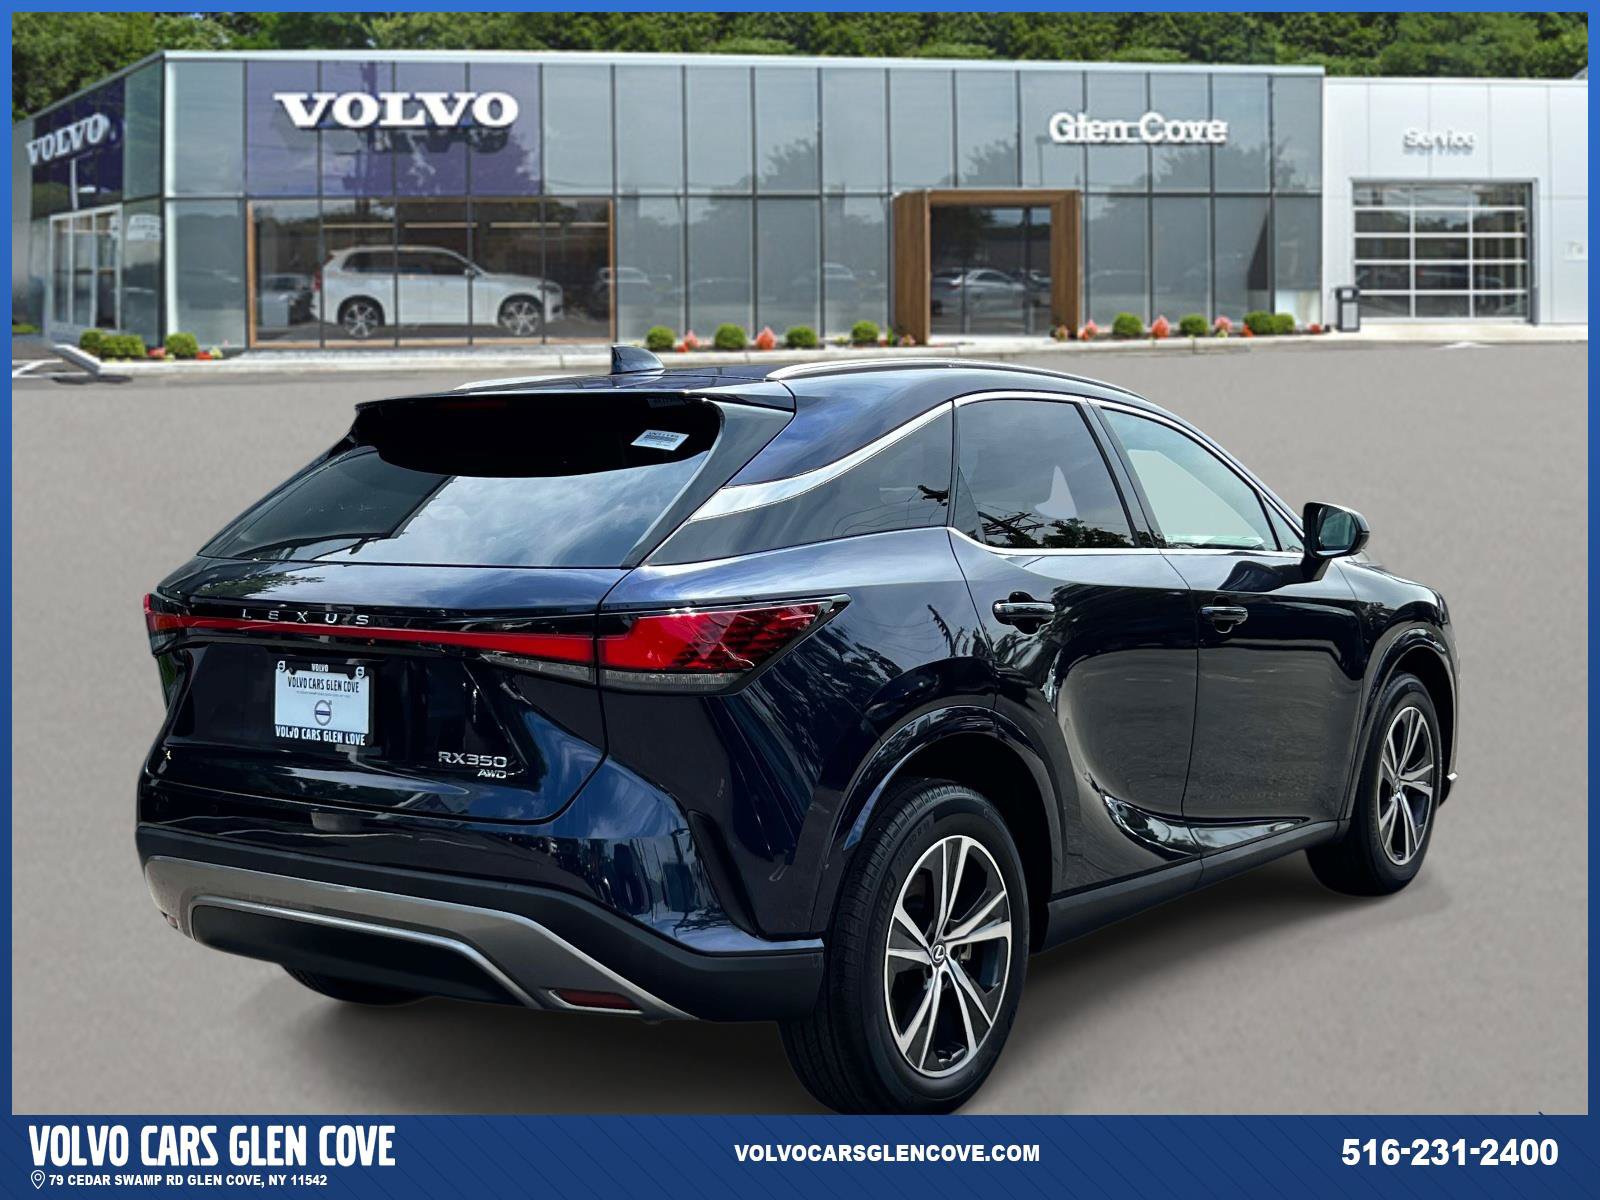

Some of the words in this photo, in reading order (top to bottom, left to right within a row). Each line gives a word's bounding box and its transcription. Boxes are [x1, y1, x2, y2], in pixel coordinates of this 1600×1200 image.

[273, 92, 519, 128] VOLVO
[1049, 111, 1132, 143] Glen
[1138, 111, 1228, 143] Cove
[25, 113, 111, 166] VOLVO
[1402, 127, 1476, 154] Service
[241, 608, 370, 626] LEXUS
[311, 663, 329, 673] VOLVO
[287, 675, 307, 690] VOLVO
[308, 677, 325, 691] CARS
[326, 679, 342, 692] GLEN
[343, 681, 360, 694] COVE
[274, 725, 299, 740] VOLVO
[301, 728, 321, 742] CARS
[323, 730, 343, 744] GLEN
[438, 751, 507, 768] RX350
[477, 768, 507, 779] AWD
